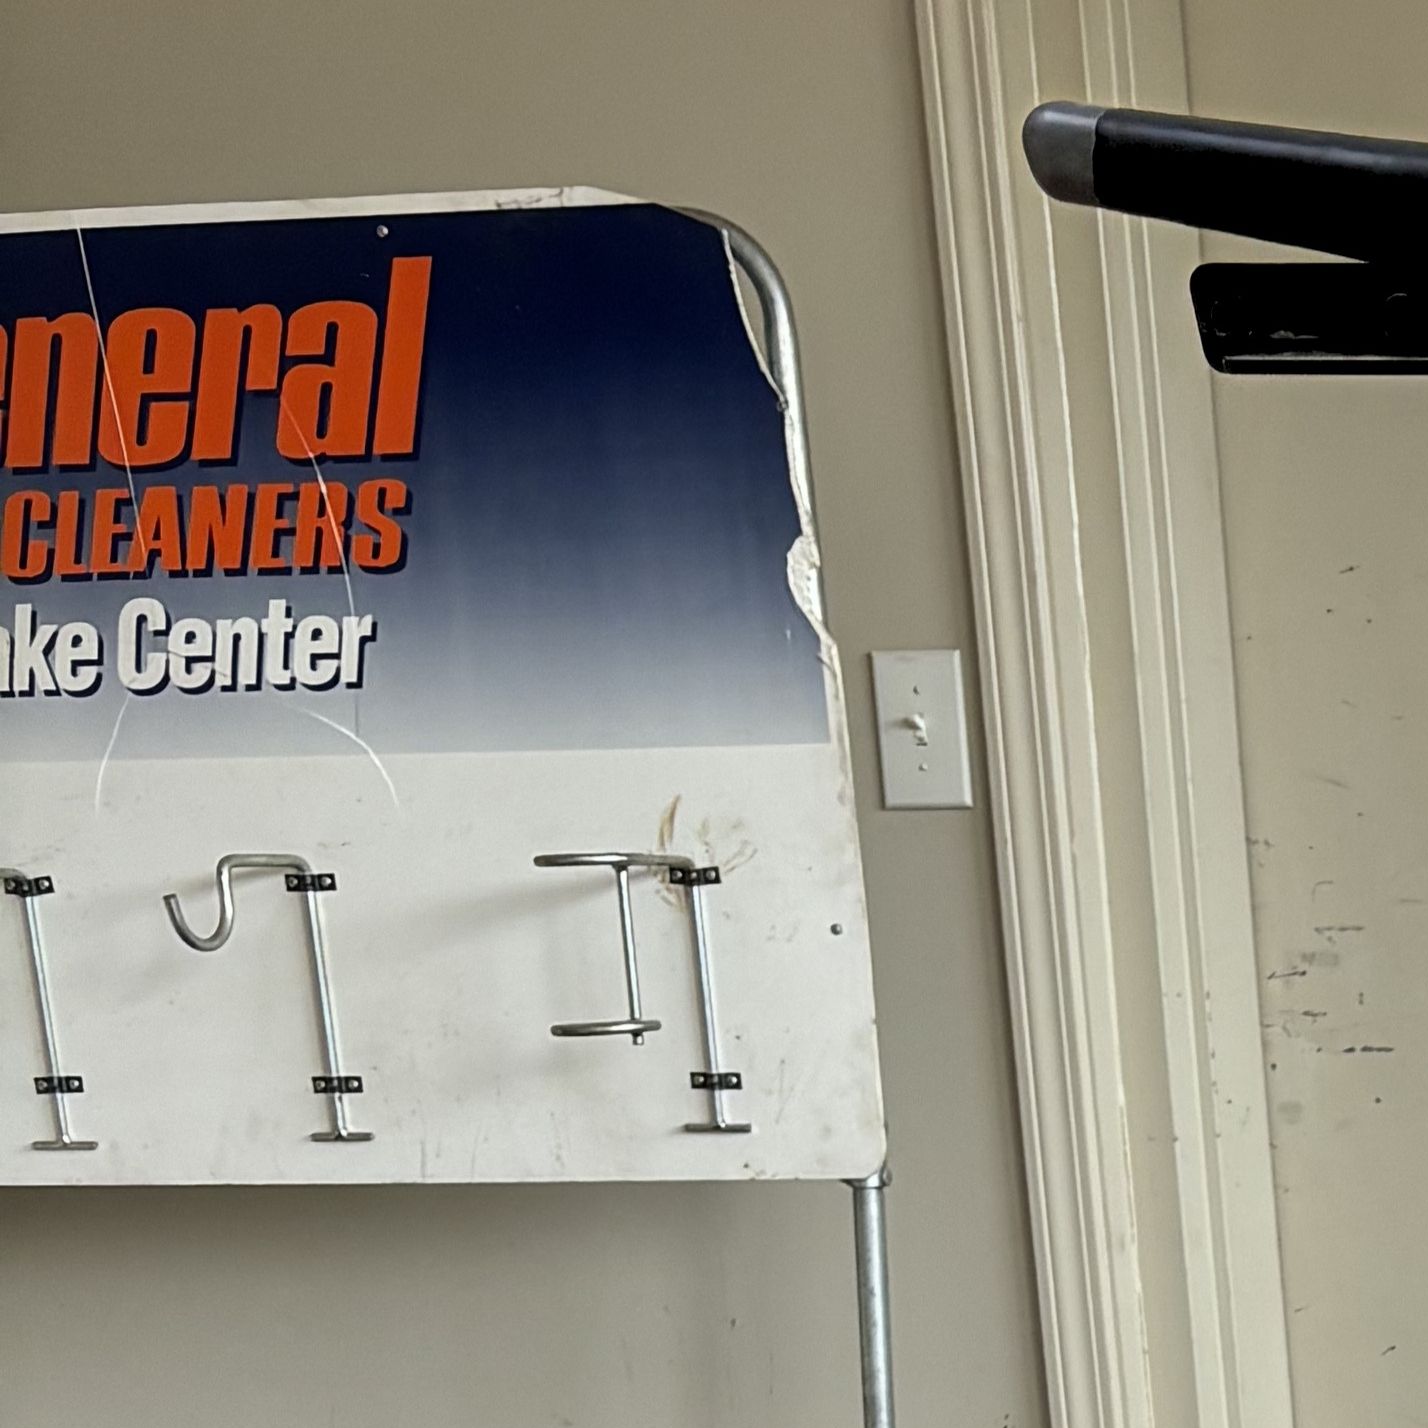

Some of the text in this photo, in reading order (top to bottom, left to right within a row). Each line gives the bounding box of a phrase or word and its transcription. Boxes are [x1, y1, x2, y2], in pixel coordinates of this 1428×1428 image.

[0, 256, 433, 469] neral
[4, 479, 408, 580] CLEANERS
[118, 597, 373, 693] Center
